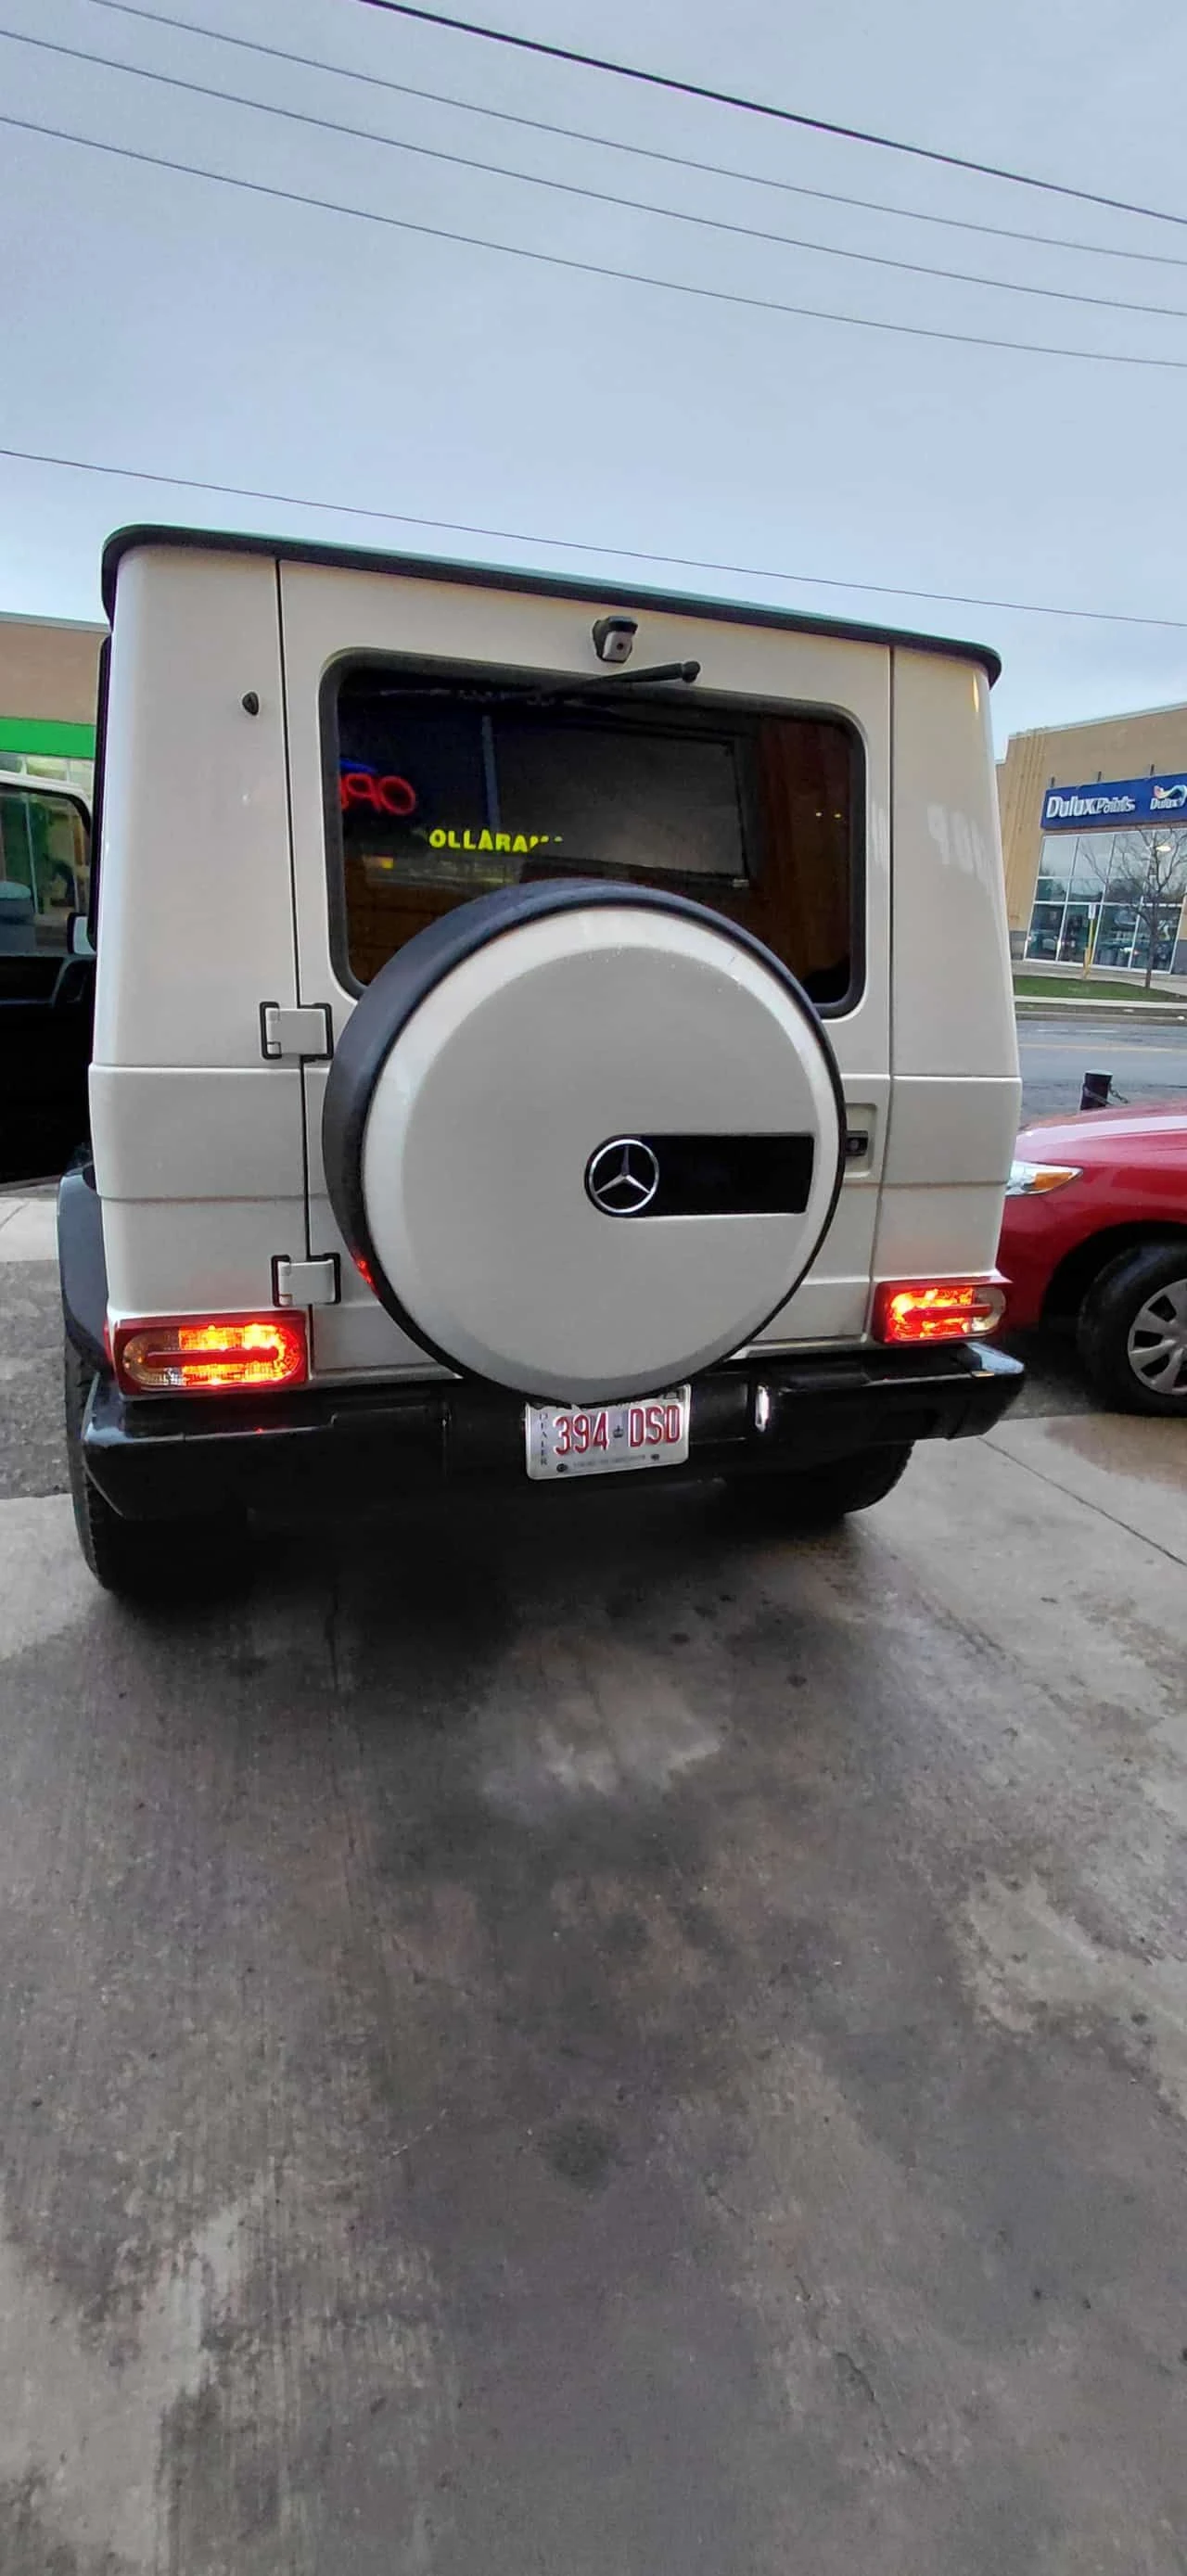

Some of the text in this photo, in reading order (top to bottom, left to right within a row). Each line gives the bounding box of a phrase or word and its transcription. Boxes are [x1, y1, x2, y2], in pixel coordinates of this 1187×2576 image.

[1046, 796, 1095, 819] Dulux
[1150, 797, 1178, 810] Dulux
[554, 1410, 609, 1455] 394
